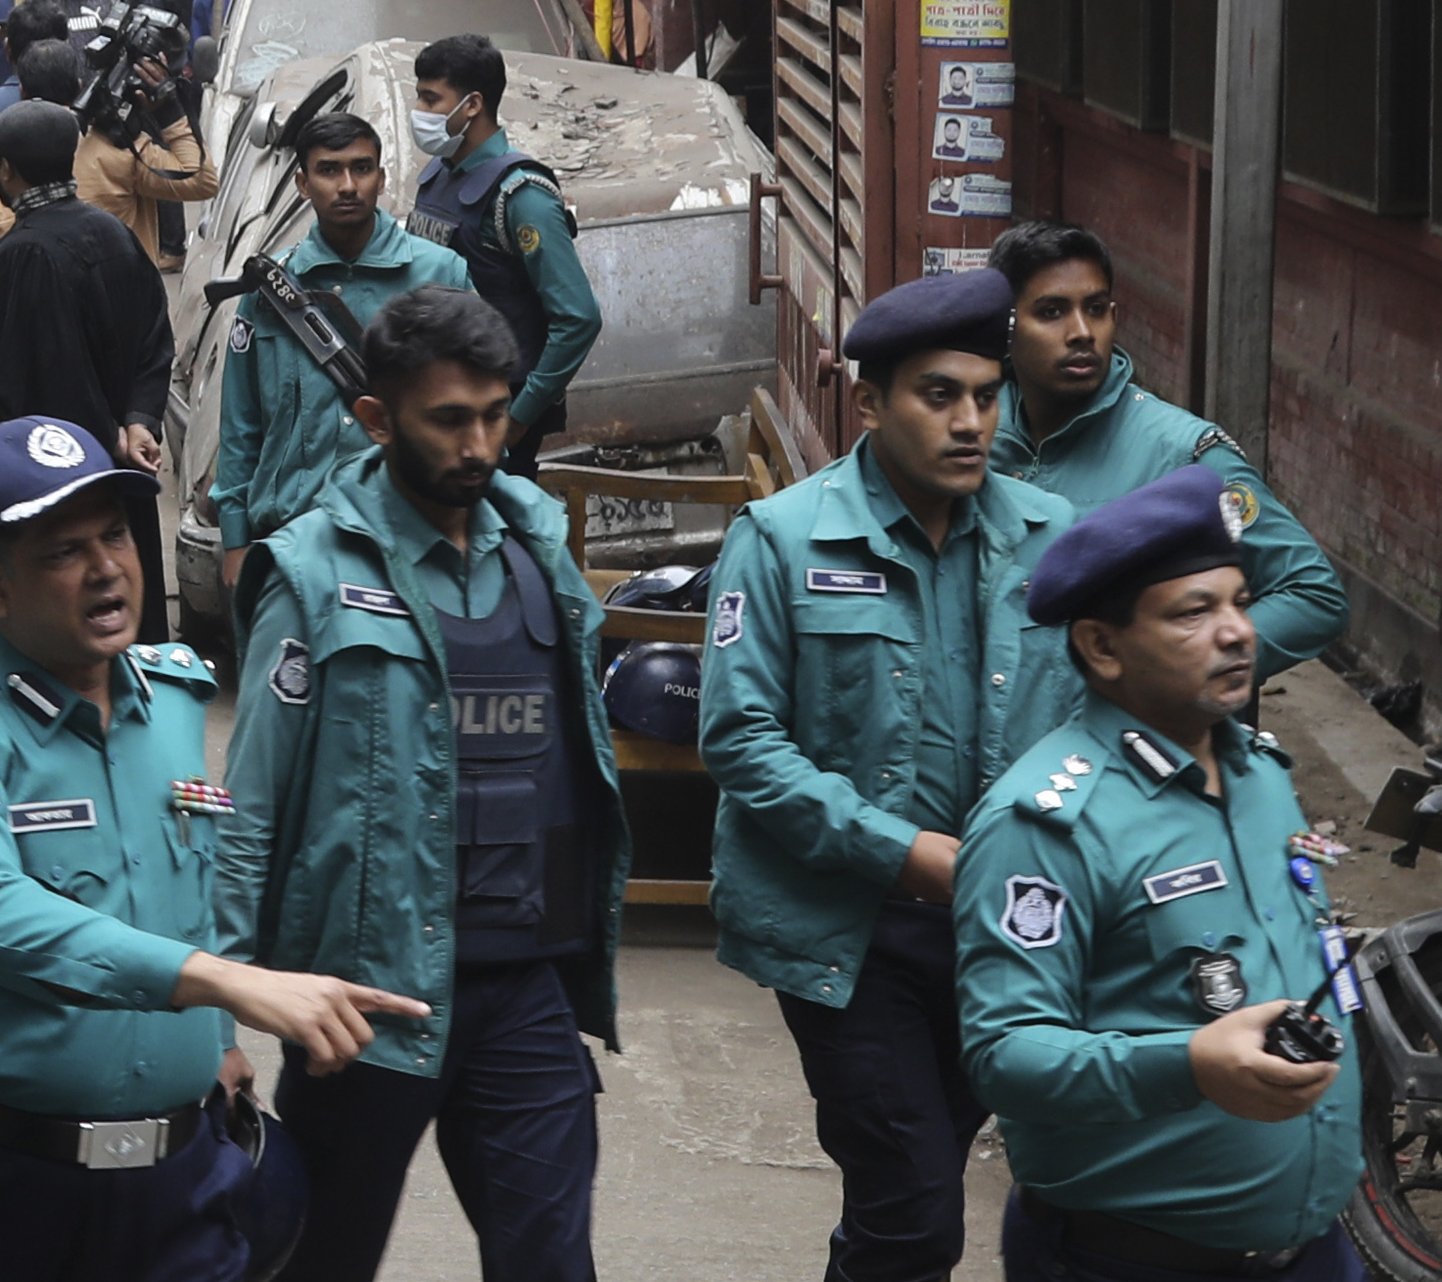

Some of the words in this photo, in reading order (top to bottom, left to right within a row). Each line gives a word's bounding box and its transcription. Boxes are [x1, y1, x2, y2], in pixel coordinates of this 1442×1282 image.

[409, 215, 451, 247] POLICE
[664, 683, 701, 701] POLIC
[451, 694, 546, 734] LICE
